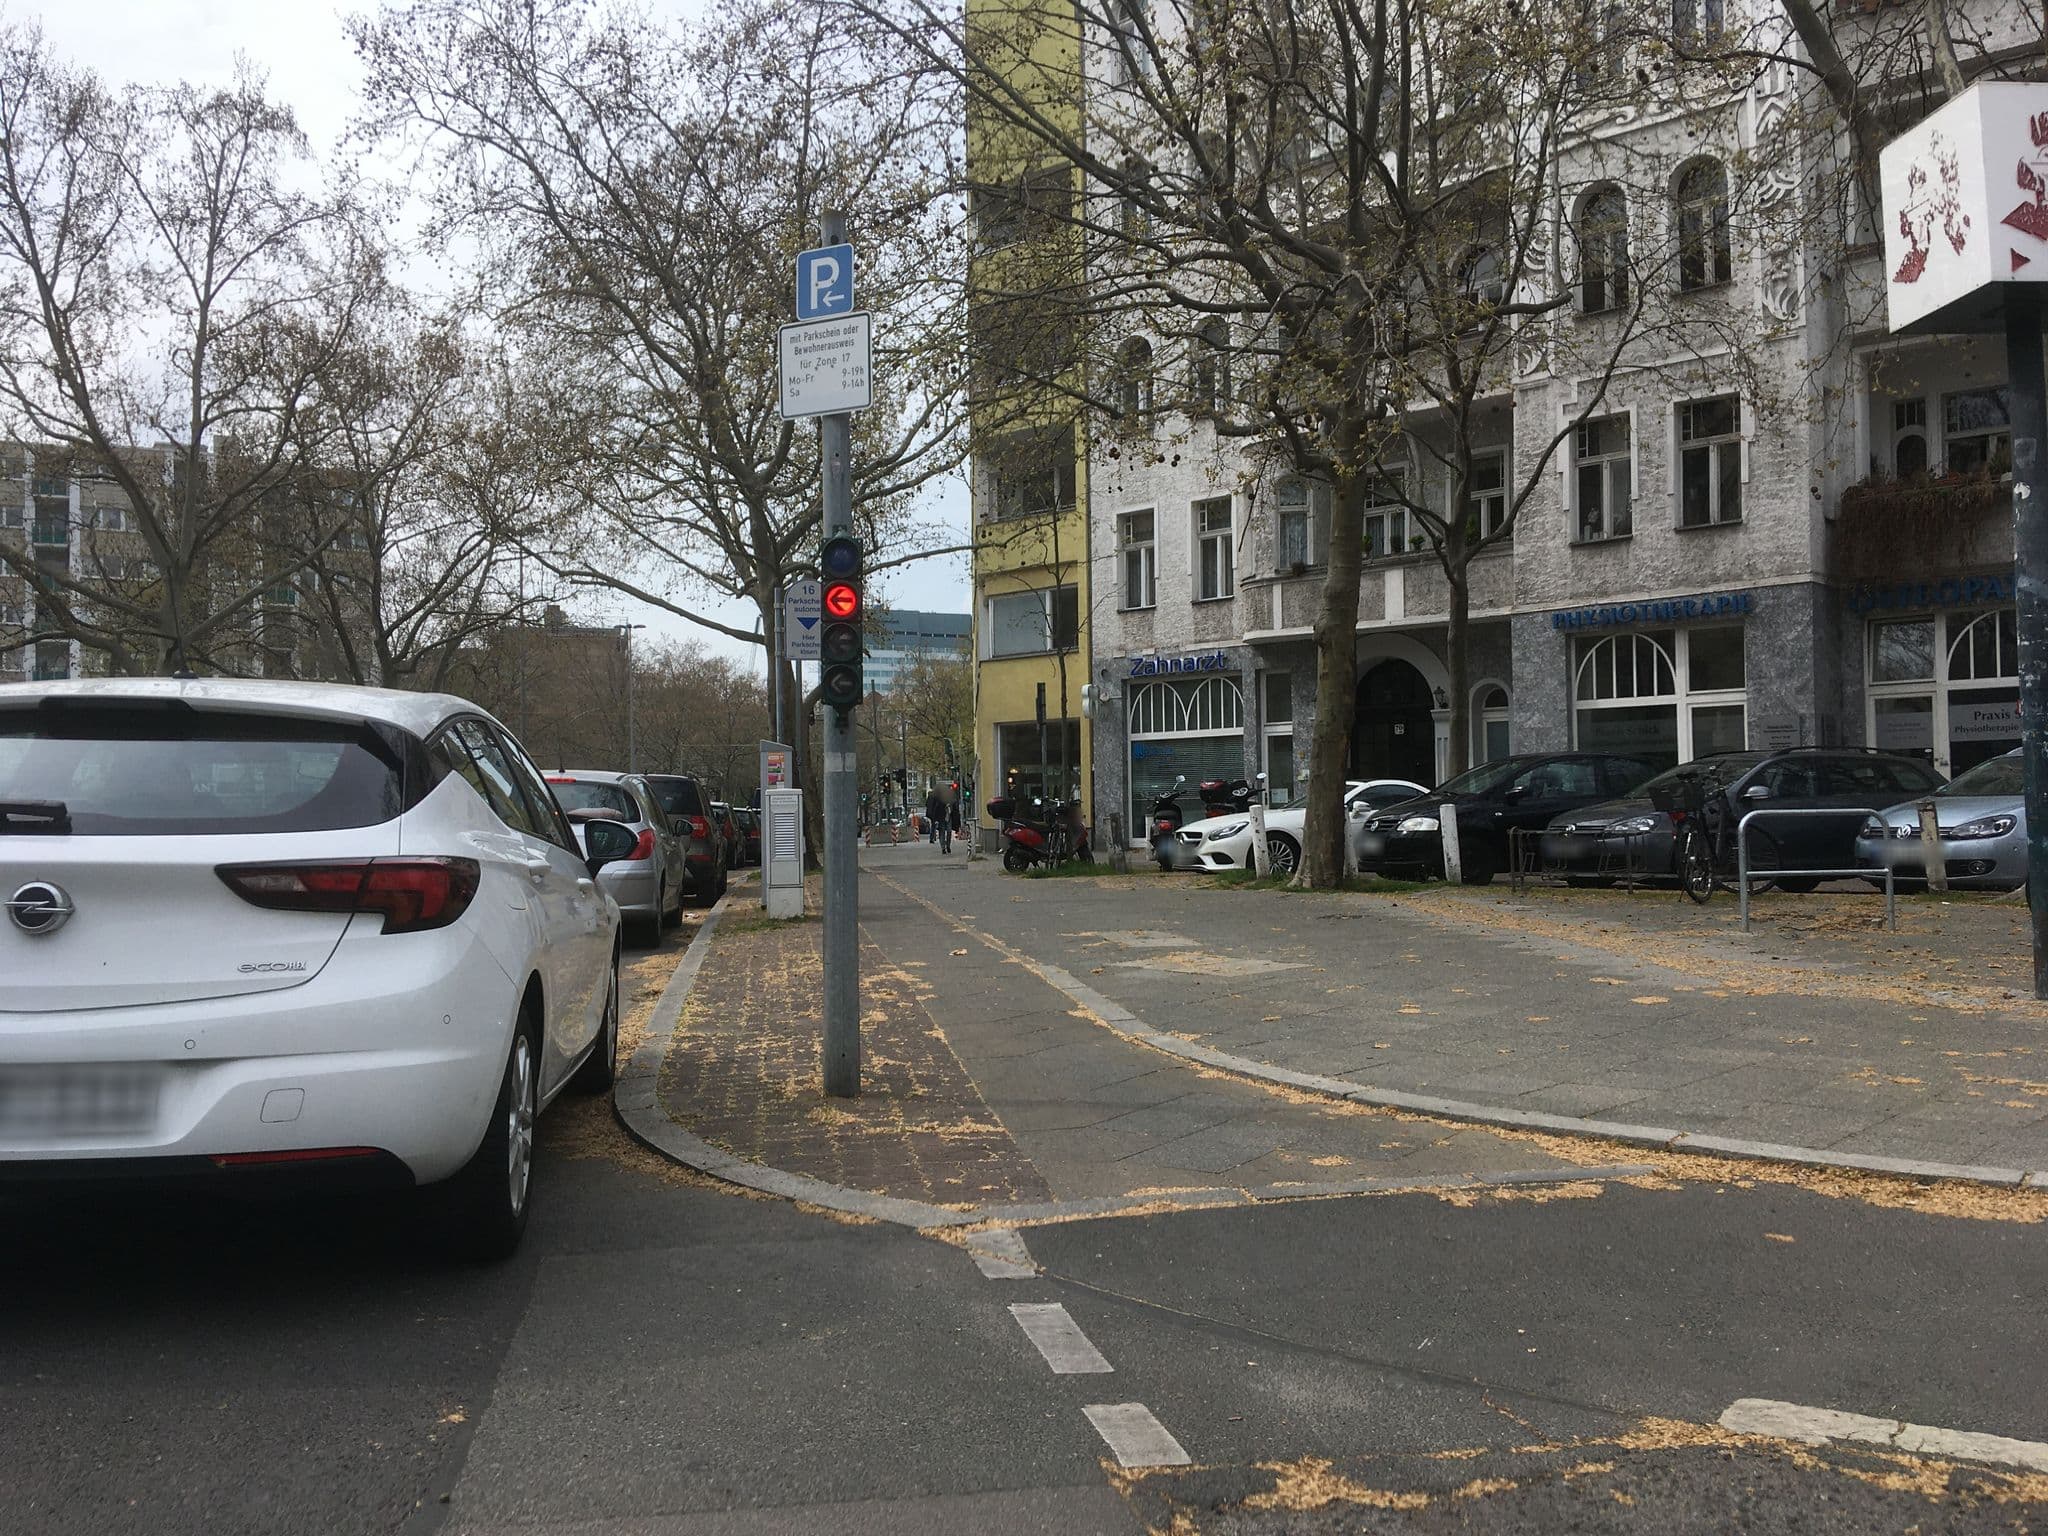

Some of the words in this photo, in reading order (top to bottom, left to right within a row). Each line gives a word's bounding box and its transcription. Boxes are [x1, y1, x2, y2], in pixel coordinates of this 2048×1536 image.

[811, 256, 840, 310] P
[790, 334, 801, 344] mit
[804, 327, 841, 341] Parkschein
[843, 324, 859, 335] oder
[794, 337, 855, 356] Bewohnerausweis
[800, 359, 812, 370] für
[816, 356, 838, 367] Zone
[842, 352, 851, 363] 17
[788, 373, 815, 386] Mo-Fr
[842, 366, 865, 377] 9-19h
[789, 387, 800, 398] Sa
[842, 378, 865, 390] 9-14h
[802, 585, 815, 595] 16
[1551, 593, 1754, 630] PHYSIOTHERAPIE
[1130, 650, 1226, 676] Zahnarzt
[1974, 709, 2010, 720] Praxis
[1954, 723, 2019, 734] Physiotherapie
